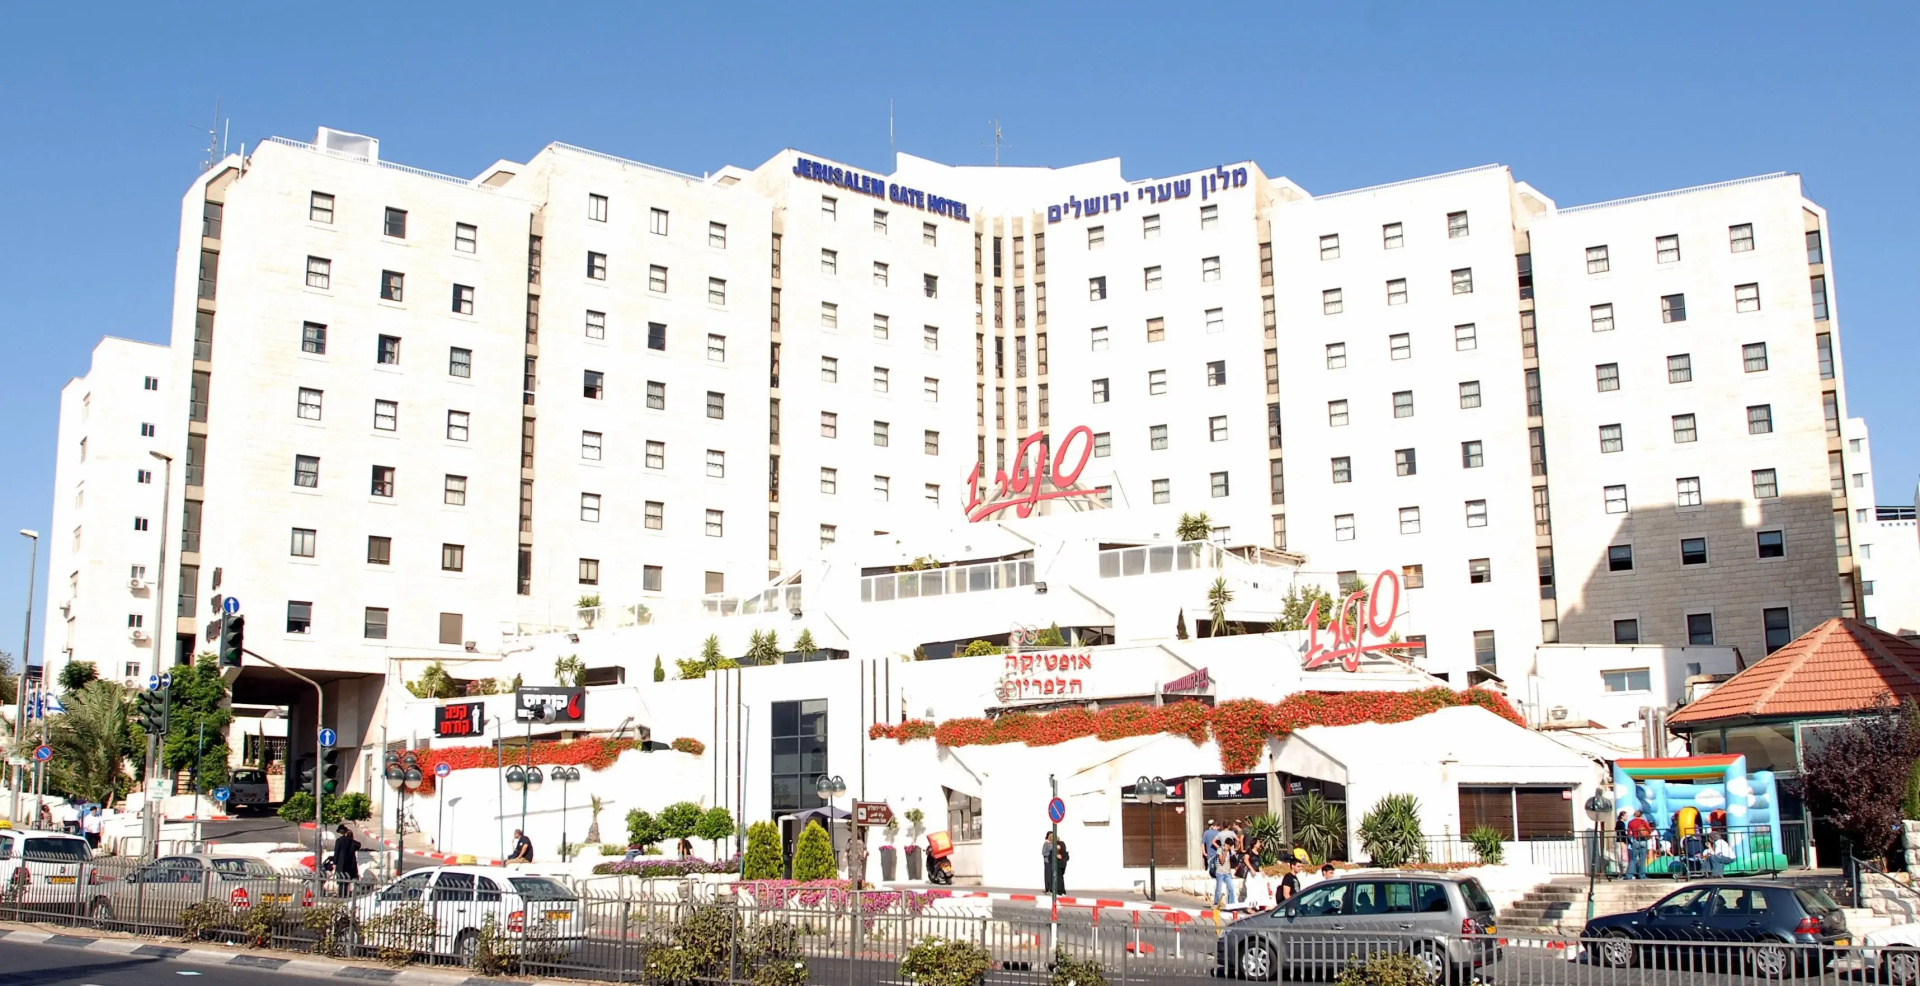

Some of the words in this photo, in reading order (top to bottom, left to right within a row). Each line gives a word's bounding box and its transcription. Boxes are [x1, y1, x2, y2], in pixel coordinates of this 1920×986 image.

[793, 157, 885, 199] JERUSALEM
[889, 183, 924, 210] GATE
[927, 193, 970, 222] HOTEL
[1138, 178, 1191, 204] שערי
[1201, 165, 1248, 201] מלון
[1048, 190, 1130, 224] ירושלים
[1005, 653, 1092, 675] אופטיקה
[445, 704, 468, 720] קפה
[440, 719, 470, 736] קורוס
